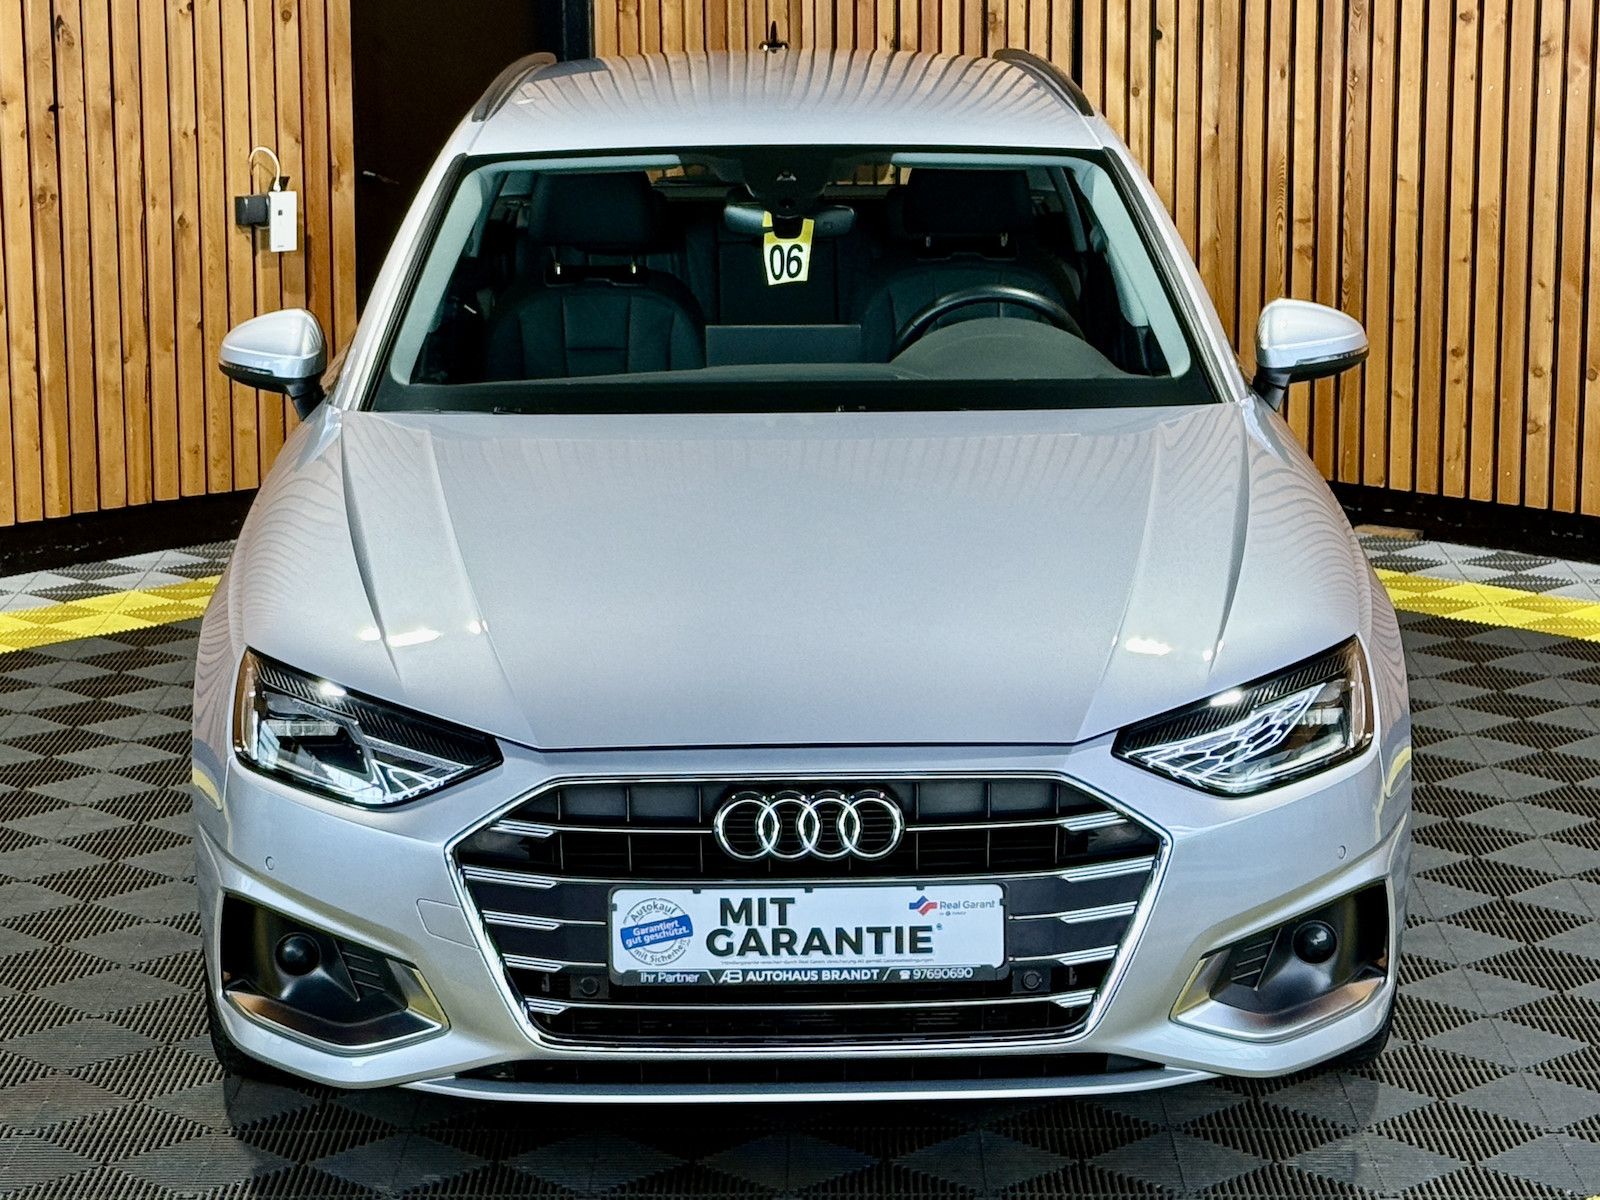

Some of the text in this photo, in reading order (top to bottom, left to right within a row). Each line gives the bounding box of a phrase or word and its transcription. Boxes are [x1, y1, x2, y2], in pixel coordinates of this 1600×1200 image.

[769, 243, 804, 281] 06
[630, 901, 678, 922] Autokauf
[939, 899, 996, 910] Real Garant
[720, 897, 795, 927] MIT
[632, 919, 679, 936] Garantiert
[625, 936, 643, 948] gut
[640, 971, 700, 983] Ihr Partner
[745, 969, 819, 982] AUTOHAUS
[821, 968, 880, 981] BRANDT
[912, 967, 974, 980] 97690690
